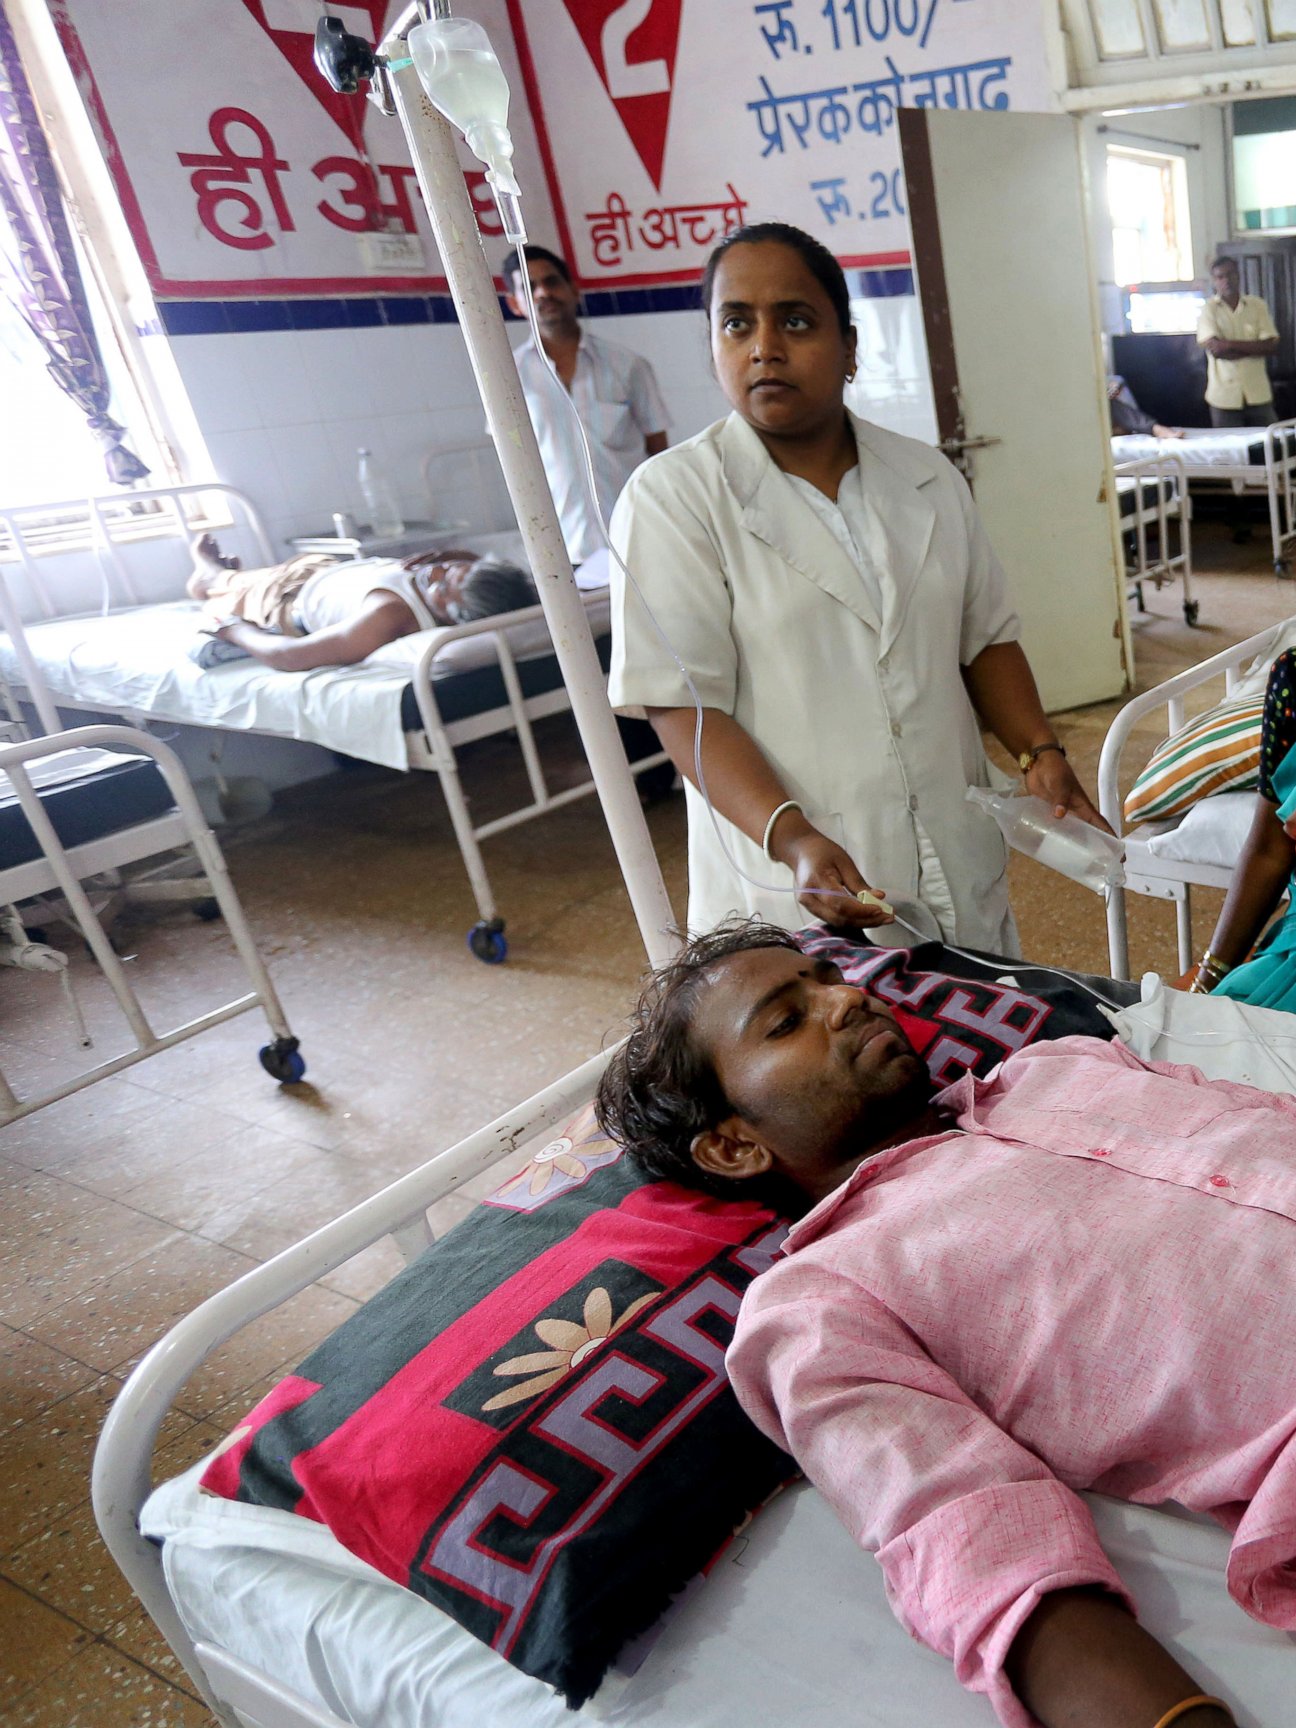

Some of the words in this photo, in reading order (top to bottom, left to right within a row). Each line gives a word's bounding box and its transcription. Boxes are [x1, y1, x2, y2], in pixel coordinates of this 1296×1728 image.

[821, 0, 976, 49] 1100/
[746, 75, 849, 158] प्रेरक
[176, 107, 296, 250] ही
[585, 192, 634, 266] ही
